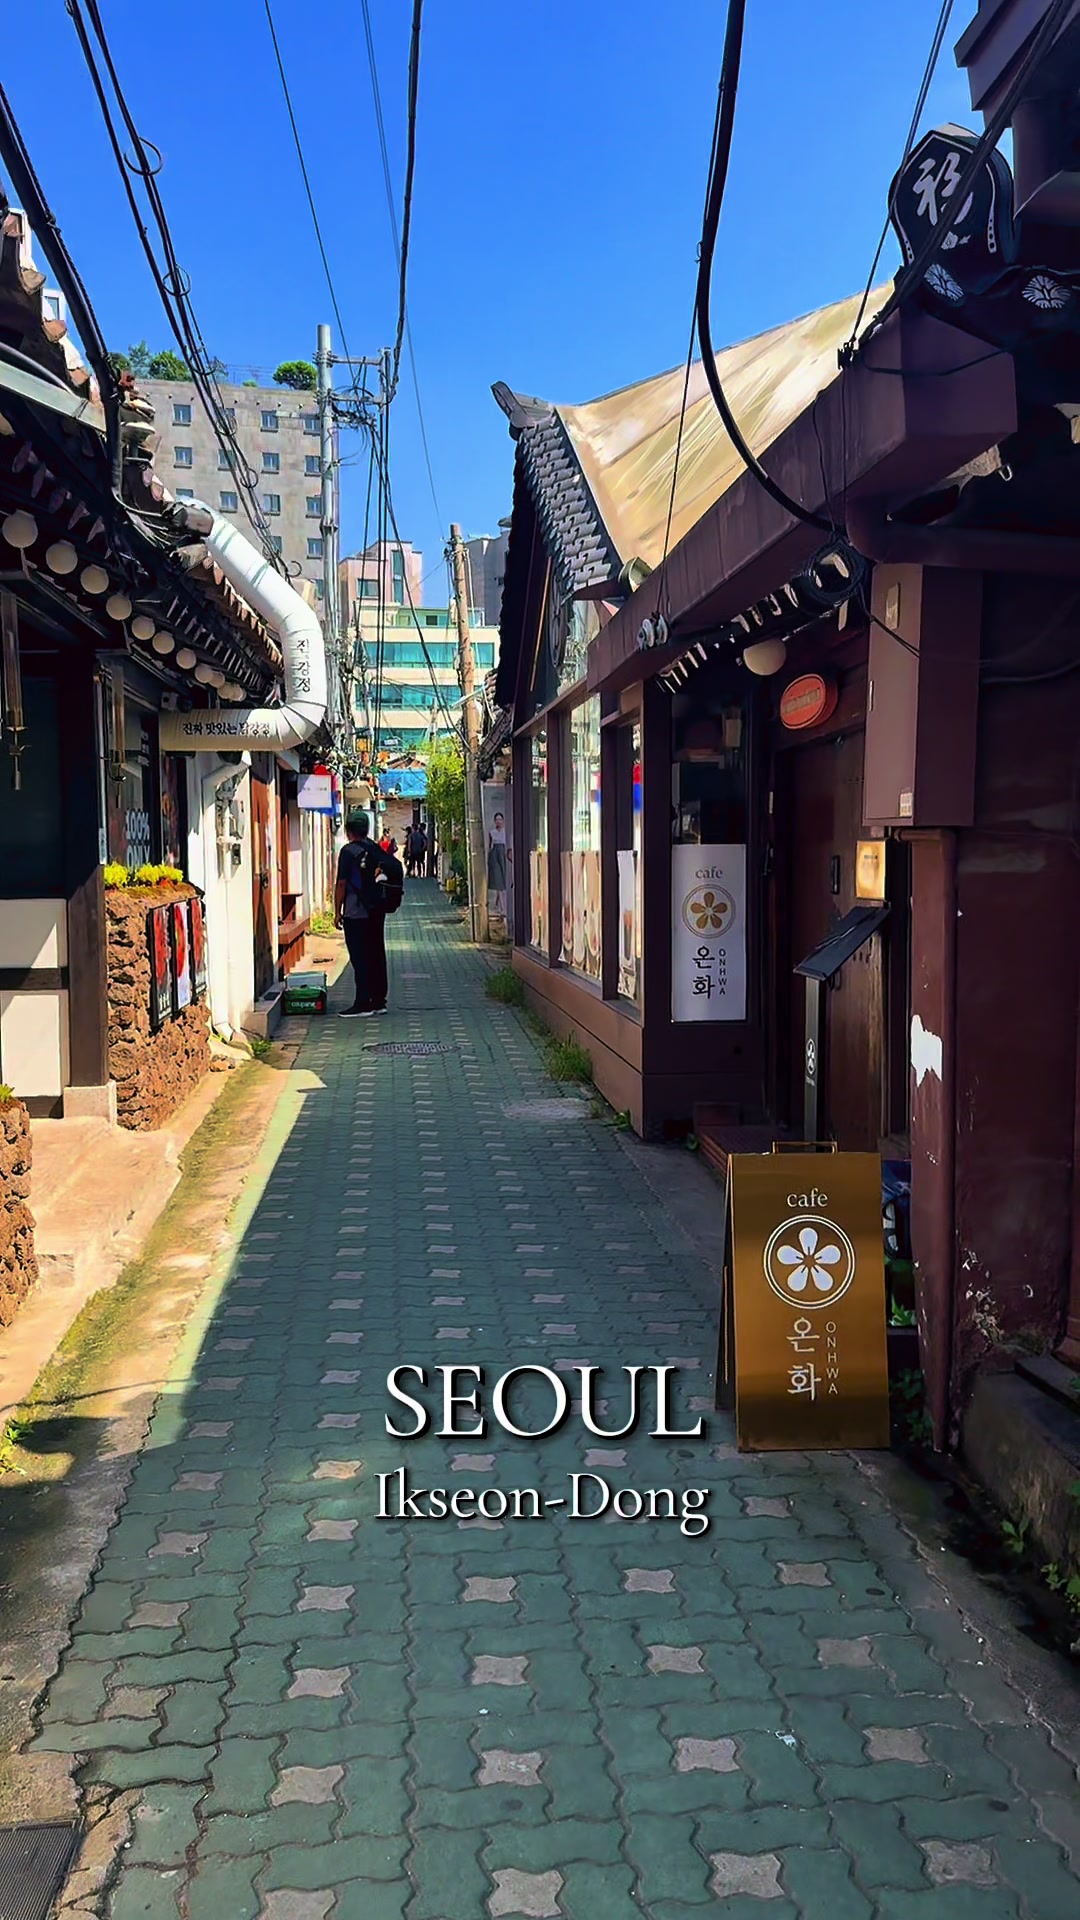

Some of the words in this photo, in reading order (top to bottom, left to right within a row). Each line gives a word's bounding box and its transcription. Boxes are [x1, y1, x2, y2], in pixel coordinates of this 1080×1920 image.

[205, 721, 238, 736] 맛있는
[694, 866, 724, 880] cafe
[786, 1187, 829, 1209] cafe
